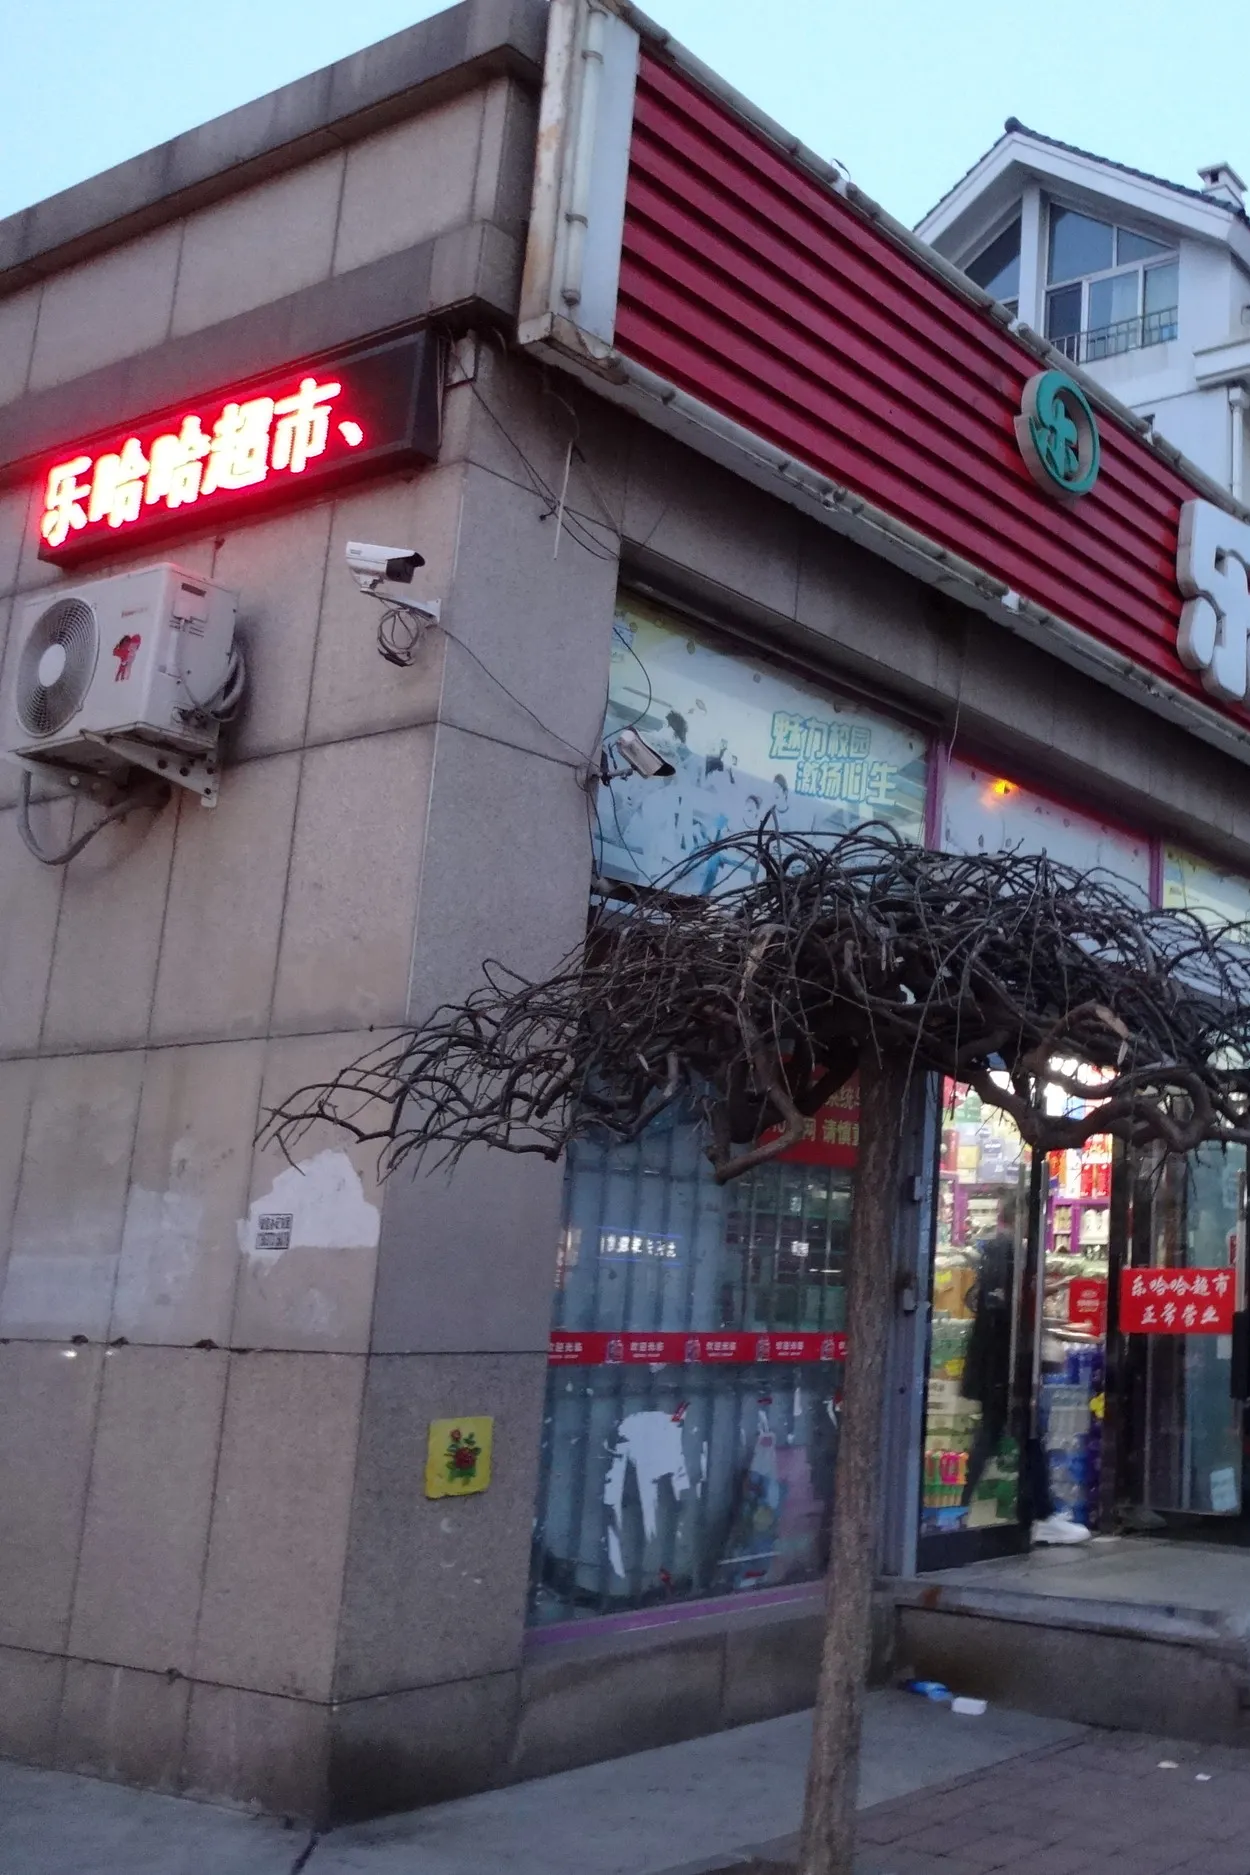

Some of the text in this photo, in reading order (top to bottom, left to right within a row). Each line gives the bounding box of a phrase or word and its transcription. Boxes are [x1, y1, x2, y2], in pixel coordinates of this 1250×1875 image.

[768, 709, 872, 760] 魅力校园
[1130, 1271, 1231, 1299] 乐哈哈超市
[1140, 1301, 1221, 1328] 正常营业
